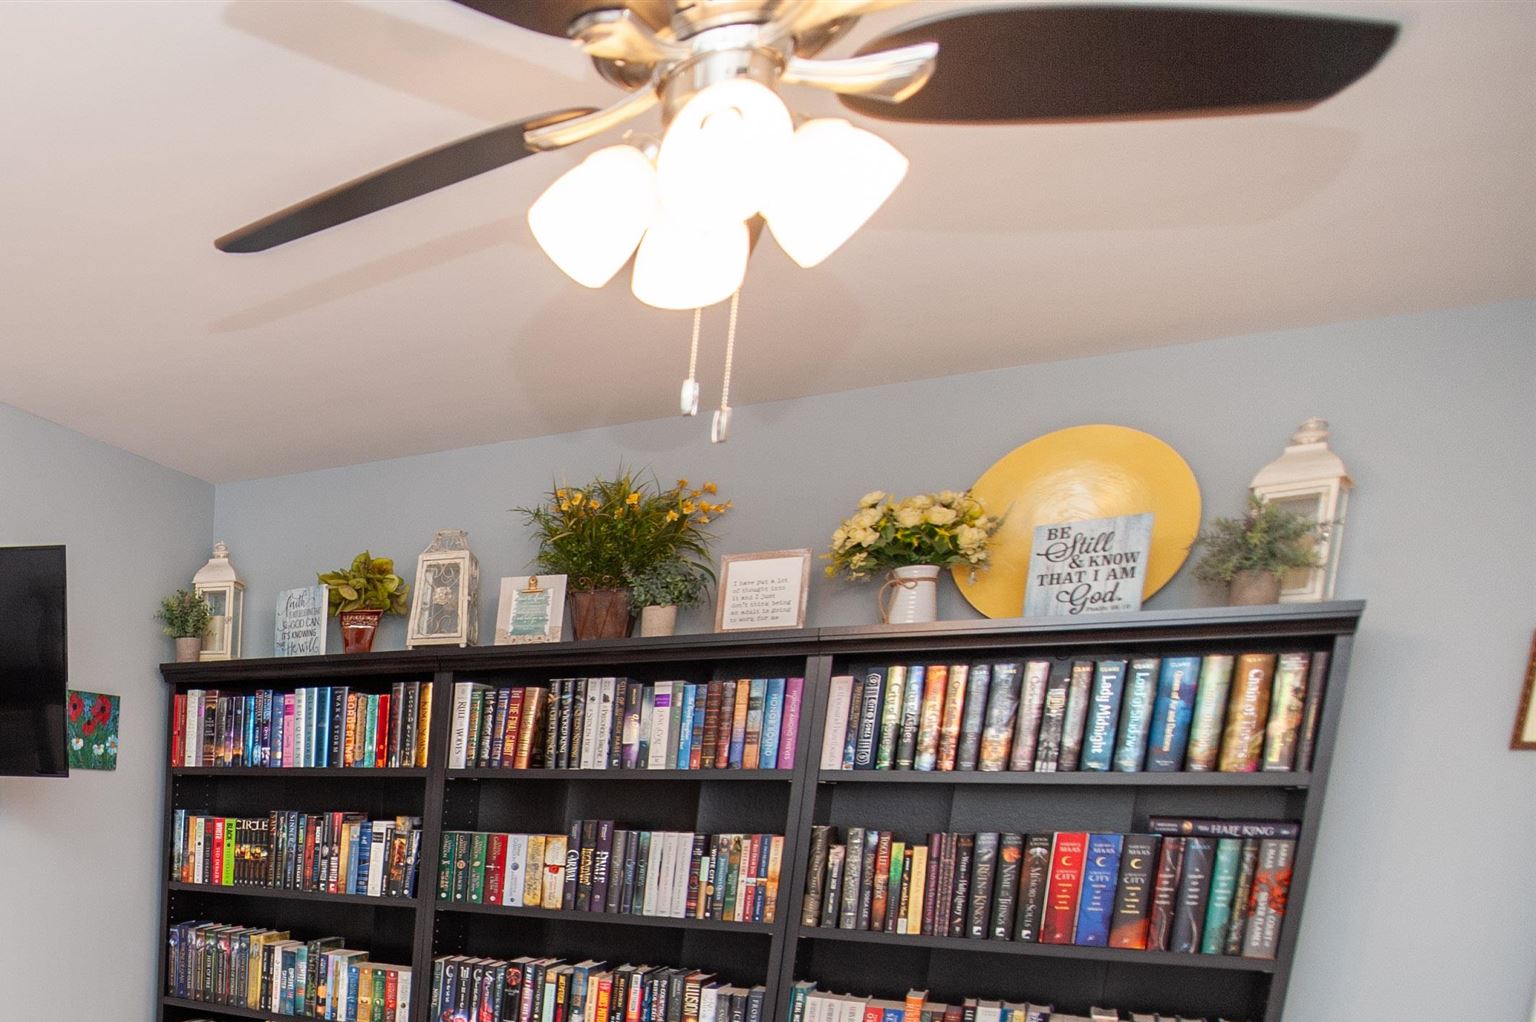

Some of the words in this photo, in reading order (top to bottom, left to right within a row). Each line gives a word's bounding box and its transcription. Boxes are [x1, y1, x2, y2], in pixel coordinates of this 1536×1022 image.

[1047, 526, 1071, 540] BE
[1036, 531, 1114, 562] Still
[1069, 554, 1084, 569] &
[1088, 552, 1140, 567] KNOW
[1037, 570, 1086, 586] THAT
[1093, 569, 1100, 581] I
[1106, 566, 1136, 581] AM
[1095, 675, 1117, 702] Lady
[1135, 672, 1150, 696] Lord
[1246, 668, 1265, 702] Chain
[509, 703, 520, 715] THE
[1131, 698, 1142, 707] of
[1244, 704, 1257, 716] of
[902, 714, 917, 744] Ashes
[1090, 704, 1111, 754] Midnight
[235, 819, 268, 831] CIRCLE
[1242, 825, 1275, 836] KING
[880, 836, 890, 855] TOSCA
[565, 849, 579, 883] CARAVAL
[593, 850, 609, 883] FINALE
[709, 848, 717, 869] WHITE
[880, 856, 889, 865] LEE
[977, 863, 991, 889] RUIN
[1001, 864, 1016, 888] NAME
[974, 895, 988, 925] KINGS
[998, 896, 1013, 925] THINGS
[1024, 904, 1036, 927] SOULS
[1250, 917, 1264, 947] FLAMES
[1263, 915, 1276, 941] COURT
[445, 965, 454, 1003] Cress
[684, 983, 700, 1016] ILLUSION
[965, 1010, 974, 1021] LEE
